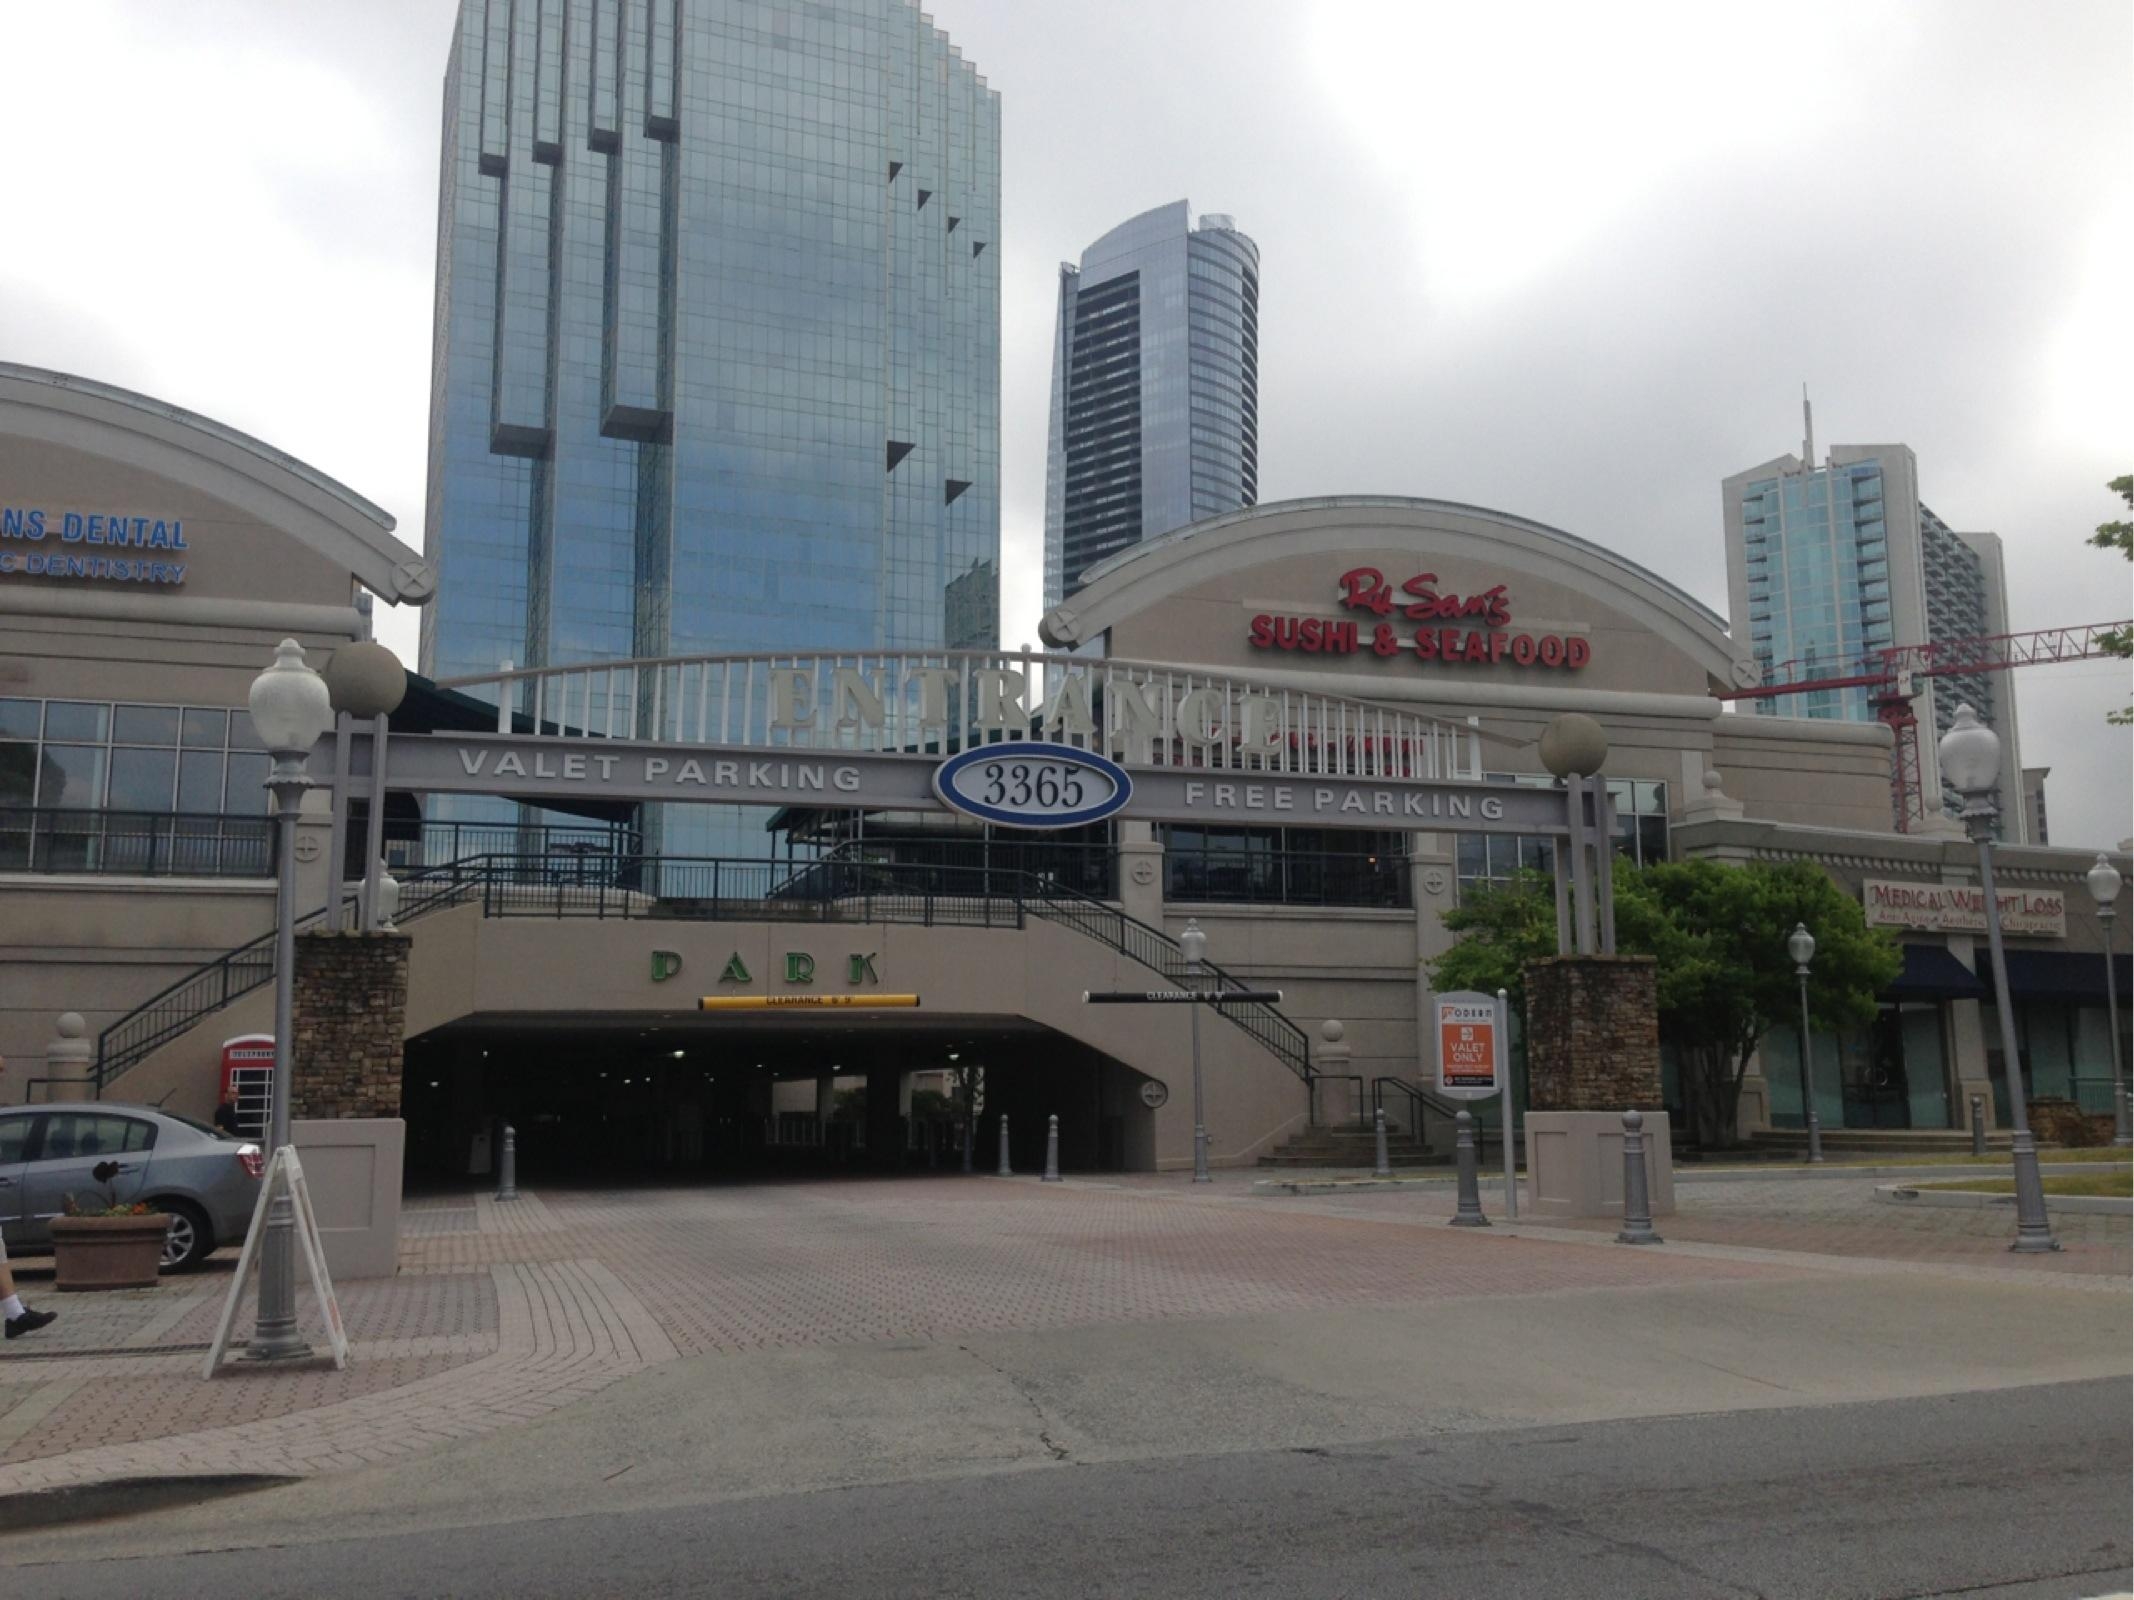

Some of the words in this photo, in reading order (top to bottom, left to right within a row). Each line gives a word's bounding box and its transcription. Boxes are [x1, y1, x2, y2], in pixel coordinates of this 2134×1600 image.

[2, 507, 46, 540] NS
[62, 512, 189, 549] DENTAL
[25, 553, 187, 585] DENTISTRY
[1251, 614, 1359, 653] SUSHI
[1373, 623, 1400, 657] &
[1414, 626, 1592, 669] SEAFOOD
[769, 667, 1284, 756] ENTRANCE
[458, 747, 620, 780] VALET
[644, 757, 861, 792] PARKING
[982, 763, 1085, 809] 3365
[1186, 782, 1294, 810] FREE
[1315, 789, 1504, 820] PARKING
[1870, 884, 1946, 912] MEDICAL
[1948, 889, 2019, 914] WEIHT
[2023, 894, 2063, 916] LOSS
[651, 951, 878, 985] PARK
[1450, 1042, 1485, 1053] VALET
[1453, 1052, 1483, 1063] ONLY
